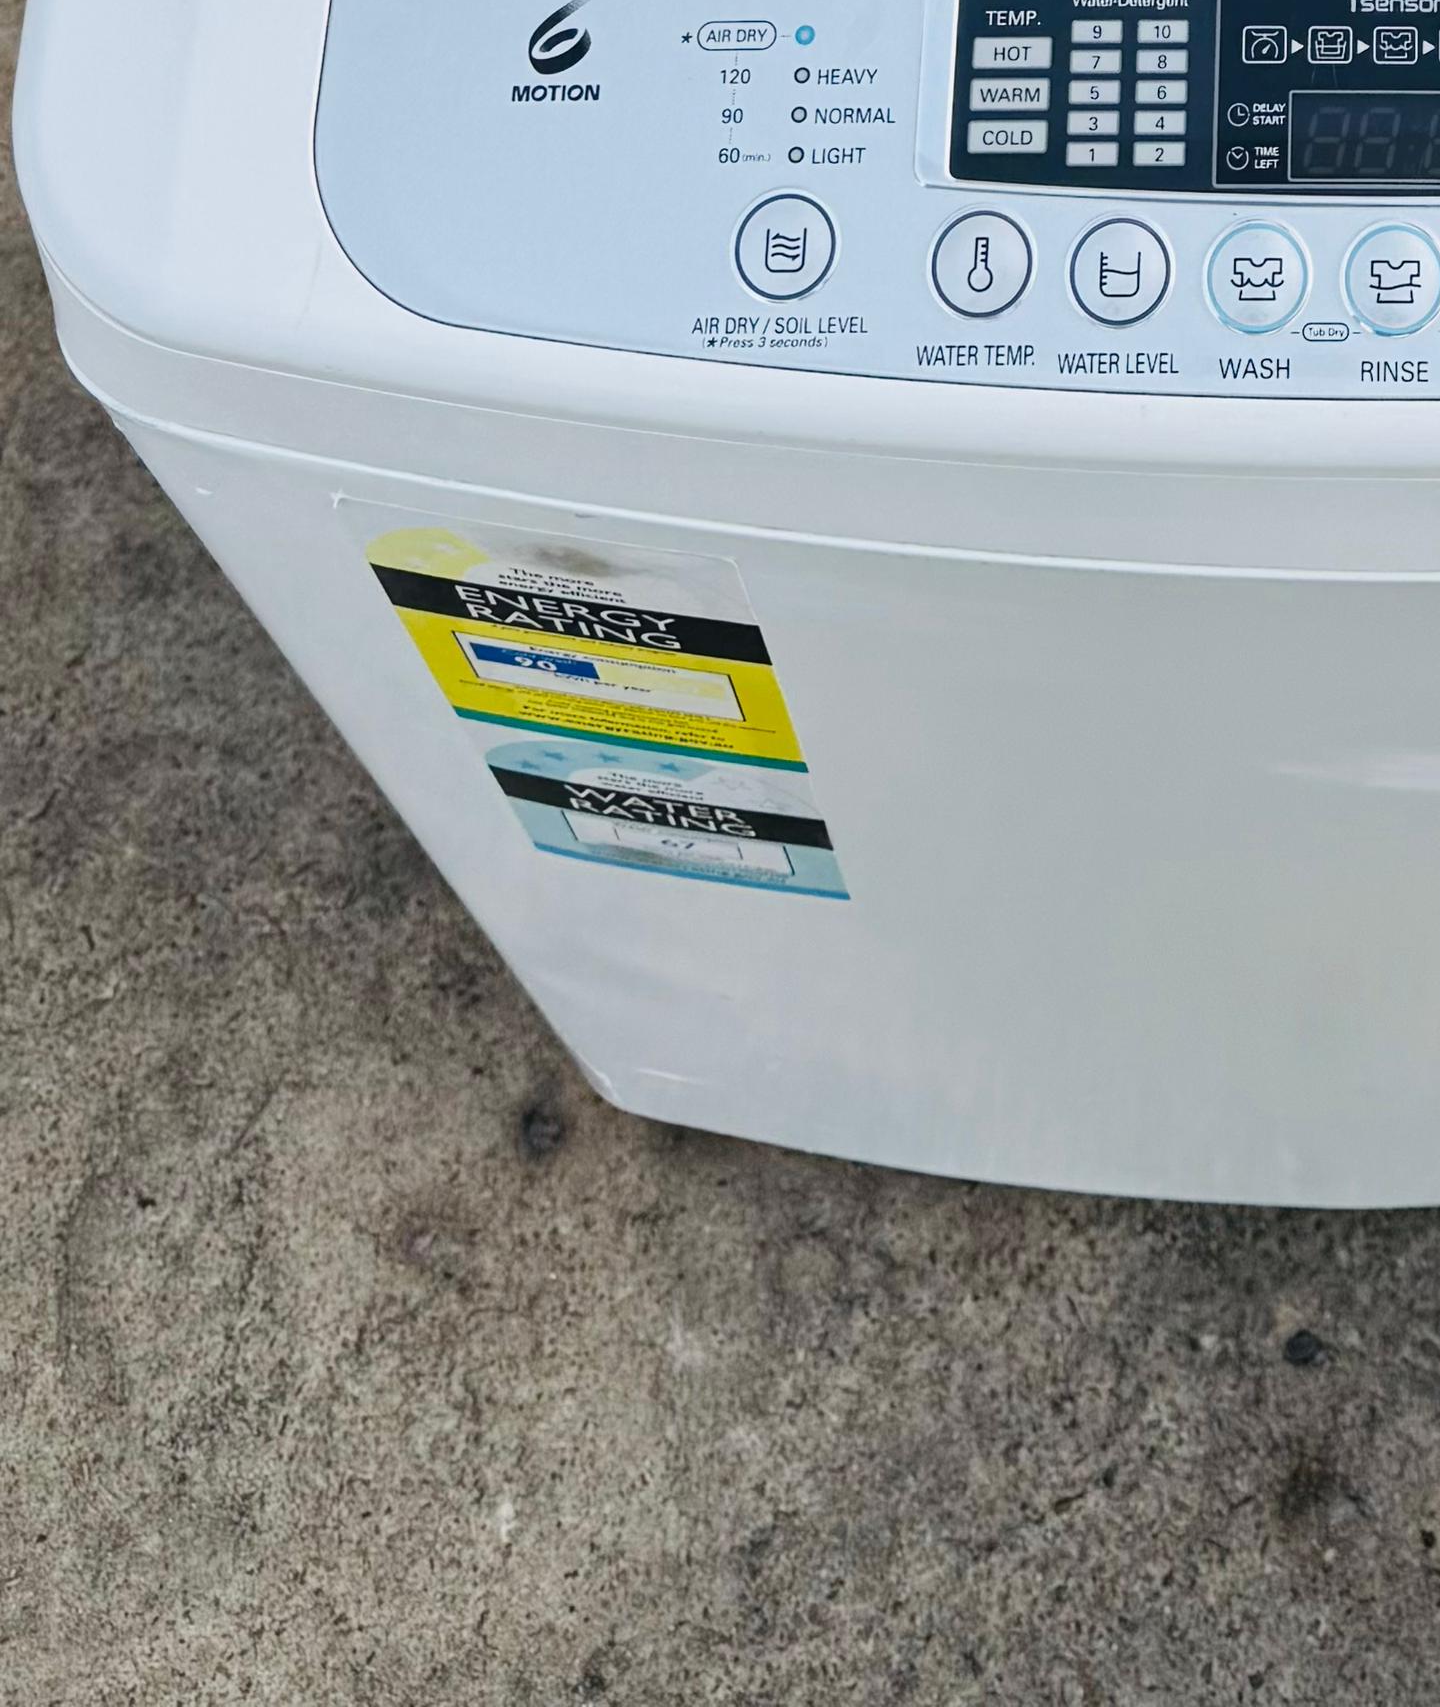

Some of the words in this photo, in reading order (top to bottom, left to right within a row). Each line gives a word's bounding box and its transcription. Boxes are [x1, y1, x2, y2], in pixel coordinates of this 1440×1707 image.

[985, 10, 1041, 26] TEMP.
[706, 29, 731, 43] AIR
[736, 29, 768, 43] DRY
[1092, 25, 1102, 39] 9
[1154, 25, 1171, 39] 10
[993, 46, 1032, 61] HOT
[1092, 55, 1101, 69] 7
[1157, 55, 1167, 69] 8
[720, 69, 751, 84] 120
[817, 69, 878, 85] HEAVY
[511, 84, 600, 102] MOTION
[980, 88, 1041, 103] WARM
[1090, 86, 1100, 100] 5
[1157, 86, 1167, 100] 6
[1253, 103, 1286, 113] DELAY
[721, 108, 743, 124] 90
[814, 108, 896, 124] NORMAL
[1089, 117, 1098, 131] 3
[1155, 116, 1165, 130] 4
[1252, 115, 1286, 125] START
[982, 130, 1033, 145] COLD
[812, 148, 866, 164] LIGHT
[1089, 148, 1095, 162] 1
[1155, 148, 1164, 162] 2
[1254, 147, 1279, 157] TIME
[1254, 159, 1278, 169] LEFT
[692, 317, 720, 334] AIR
[725, 317, 759, 334] DRY
[774, 317, 813, 334] SOIL
[818, 317, 868, 334] LEVEL
[1308, 327, 1325, 336] Tub
[1328, 328, 1345, 338] Dry
[758, 337, 766, 347] 3
[916, 345, 978, 366] WATER
[984, 344, 1035, 366] TEMP.
[1058, 353, 1120, 375] WATER
[1126, 353, 1179, 375] LEVEL
[1219, 357, 1291, 380] WASH
[1361, 361, 1429, 382] RINSE
[454, 584, 676, 632] ENERGY
[466, 602, 682, 649] RATING
[514, 656, 557, 672] 90
[563, 784, 745, 824] WATER
[569, 798, 756, 837] RATING
